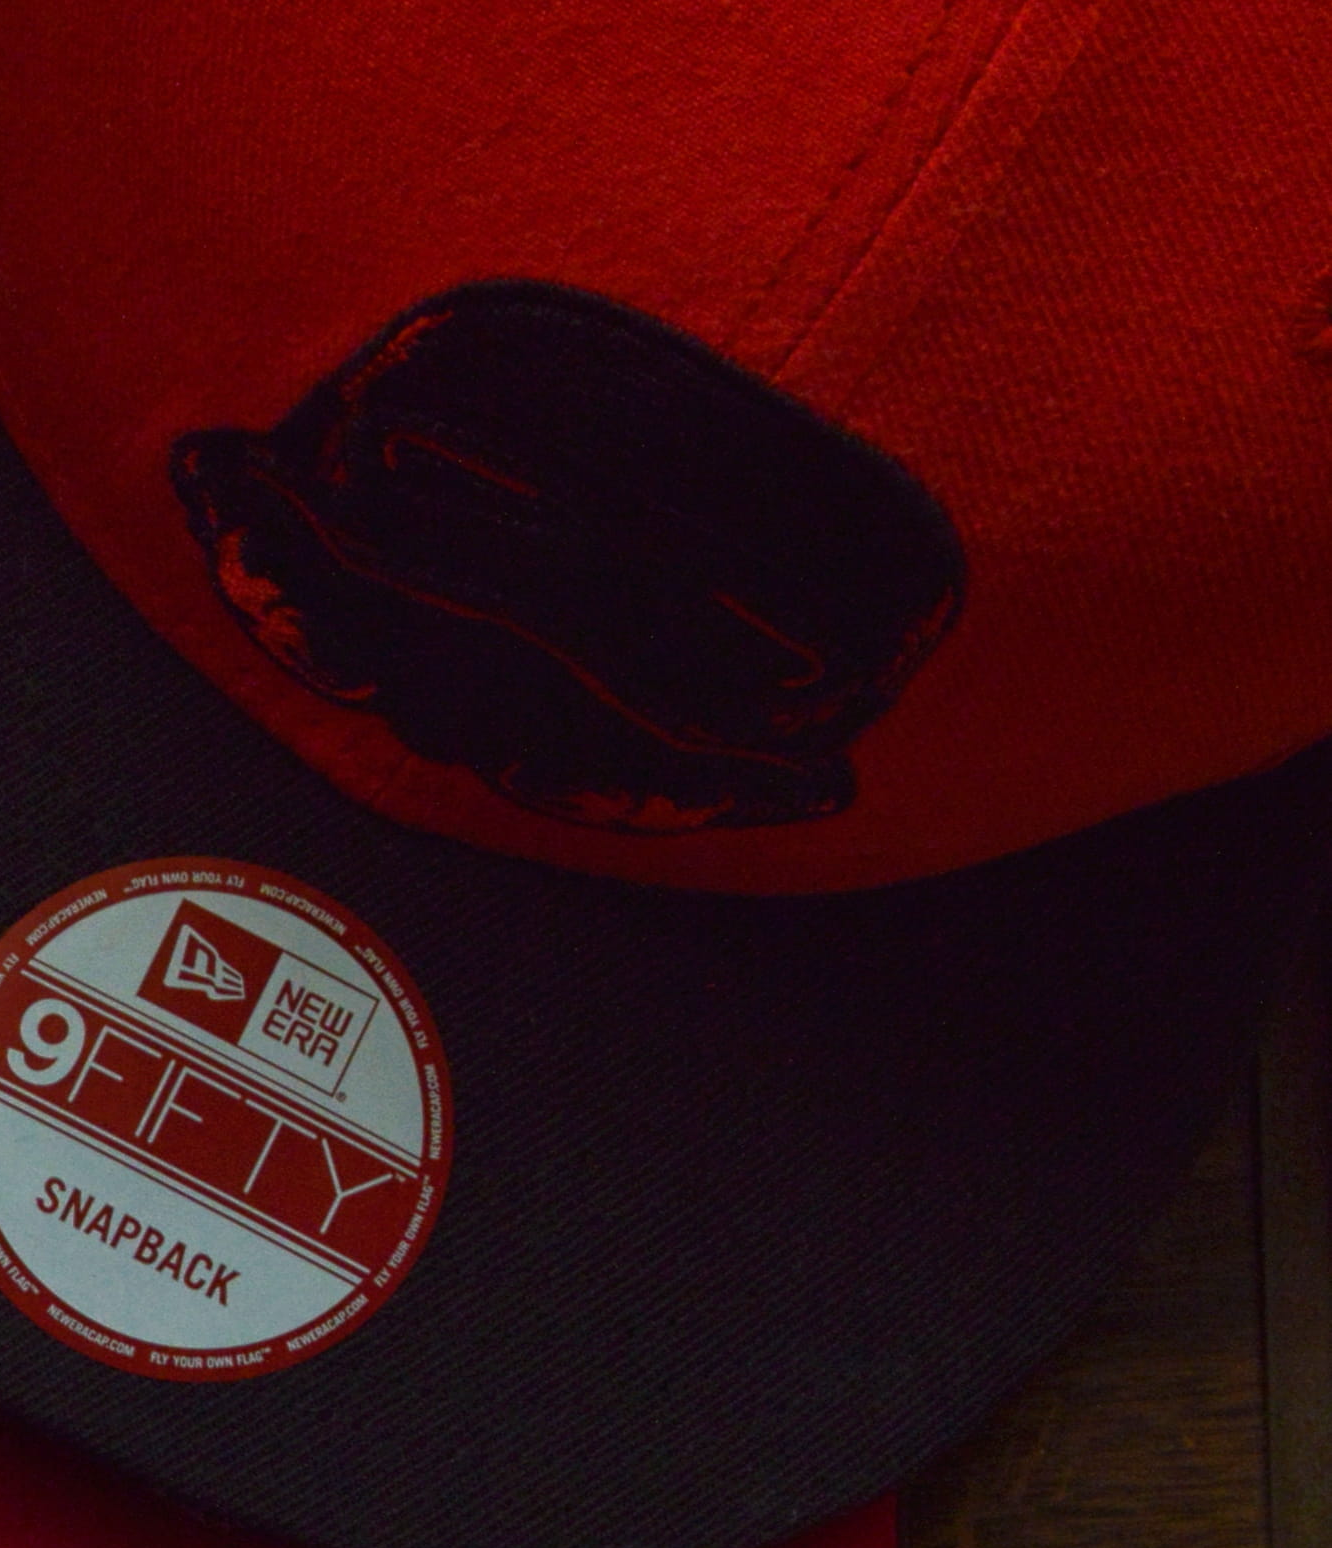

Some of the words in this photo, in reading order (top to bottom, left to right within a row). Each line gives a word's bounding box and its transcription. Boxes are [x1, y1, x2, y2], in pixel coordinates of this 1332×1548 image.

[162, 871, 188, 885] OWN
[191, 871, 222, 885] YOUR
[226, 874, 245, 888] FLY
[274, 979, 354, 1037] NEW
[262, 1008, 339, 1067] ERA
[35, 1176, 241, 1306] SNAPBACK
[373, 1267, 392, 1288] FLY
[387, 1239, 411, 1270] YOUR
[404, 1210, 425, 1243] OWN
[46, 1303, 136, 1358] NEWERACAP.COM
[285, 1293, 369, 1352] NEWERACAP.COM
[149, 1352, 170, 1367] FLY
[172, 1354, 203, 1369] YOUR
[206, 1354, 233, 1369] OWN
